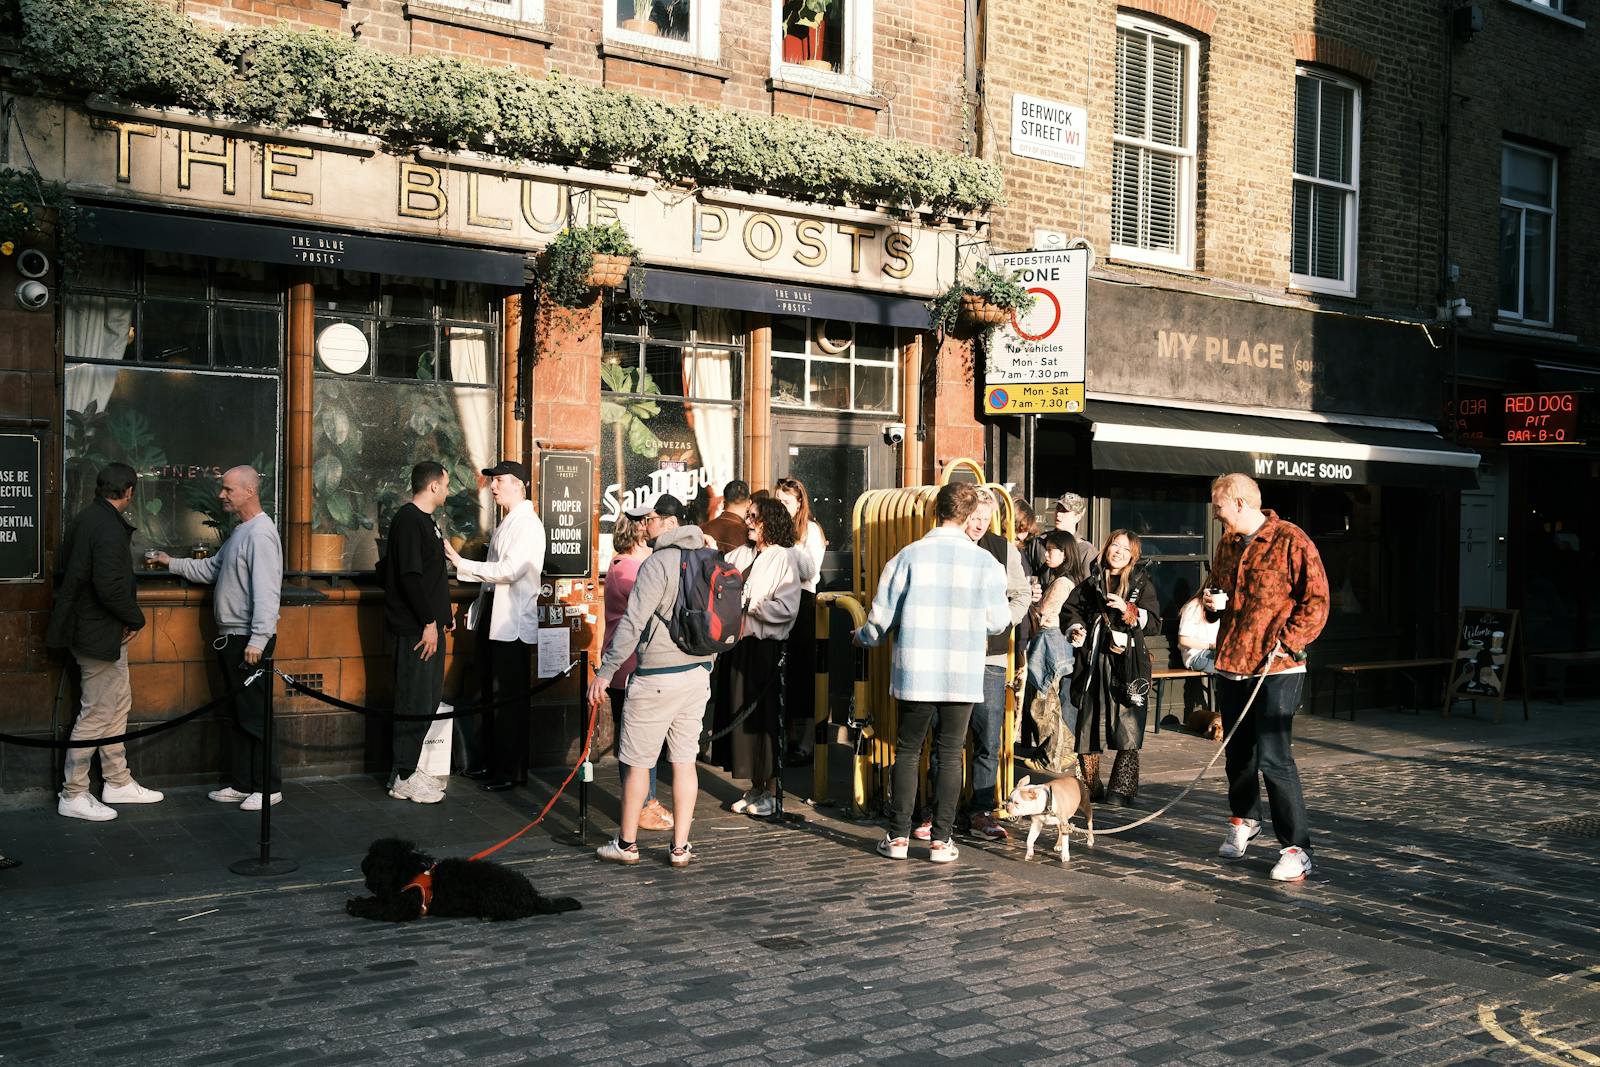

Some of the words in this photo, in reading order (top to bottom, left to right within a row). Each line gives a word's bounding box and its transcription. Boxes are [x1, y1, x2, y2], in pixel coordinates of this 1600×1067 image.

[1021, 101, 1072, 126] BERWICK
[1021, 120, 1062, 142] STREET
[1065, 129, 1080, 146] W1
[91, 118, 314, 205] THE
[692, 202, 914, 280] POSTS
[291, 236, 310, 247] THE
[319, 238, 344, 250] BLUE
[1003, 254, 1071, 266] PEDESTRIAN
[775, 289, 789, 299] THE
[793, 291, 812, 302] BLUE
[1025, 344, 1063, 353] vehicles
[1158, 329, 1198, 360] MY
[1205, 336, 1284, 370] PLACE
[1012, 358, 1033, 367] Mon
[1041, 357, 1058, 367] Sat
[1023, 387, 1044, 396] Mon
[1052, 386, 1069, 395] Sat
[1505, 396, 1535, 413] RED
[1539, 394, 1573, 412] DOG
[1525, 414, 1551, 427] PIT
[645, 440, 692, 450] CERVEZAS
[17, 470, 29, 482] BE
[1254, 459, 1273, 475] MY
[1276, 460, 1316, 477] PLACE
[1318, 463, 1353, 480] SOHO
[563, 486, 570, 498] A
[551, 500, 582, 512] PROPER
[599, 483, 651, 522] San
[558, 514, 574, 526] OLD
[550, 528, 582, 541] LONDON
[551, 542, 581, 555] BOOZER
